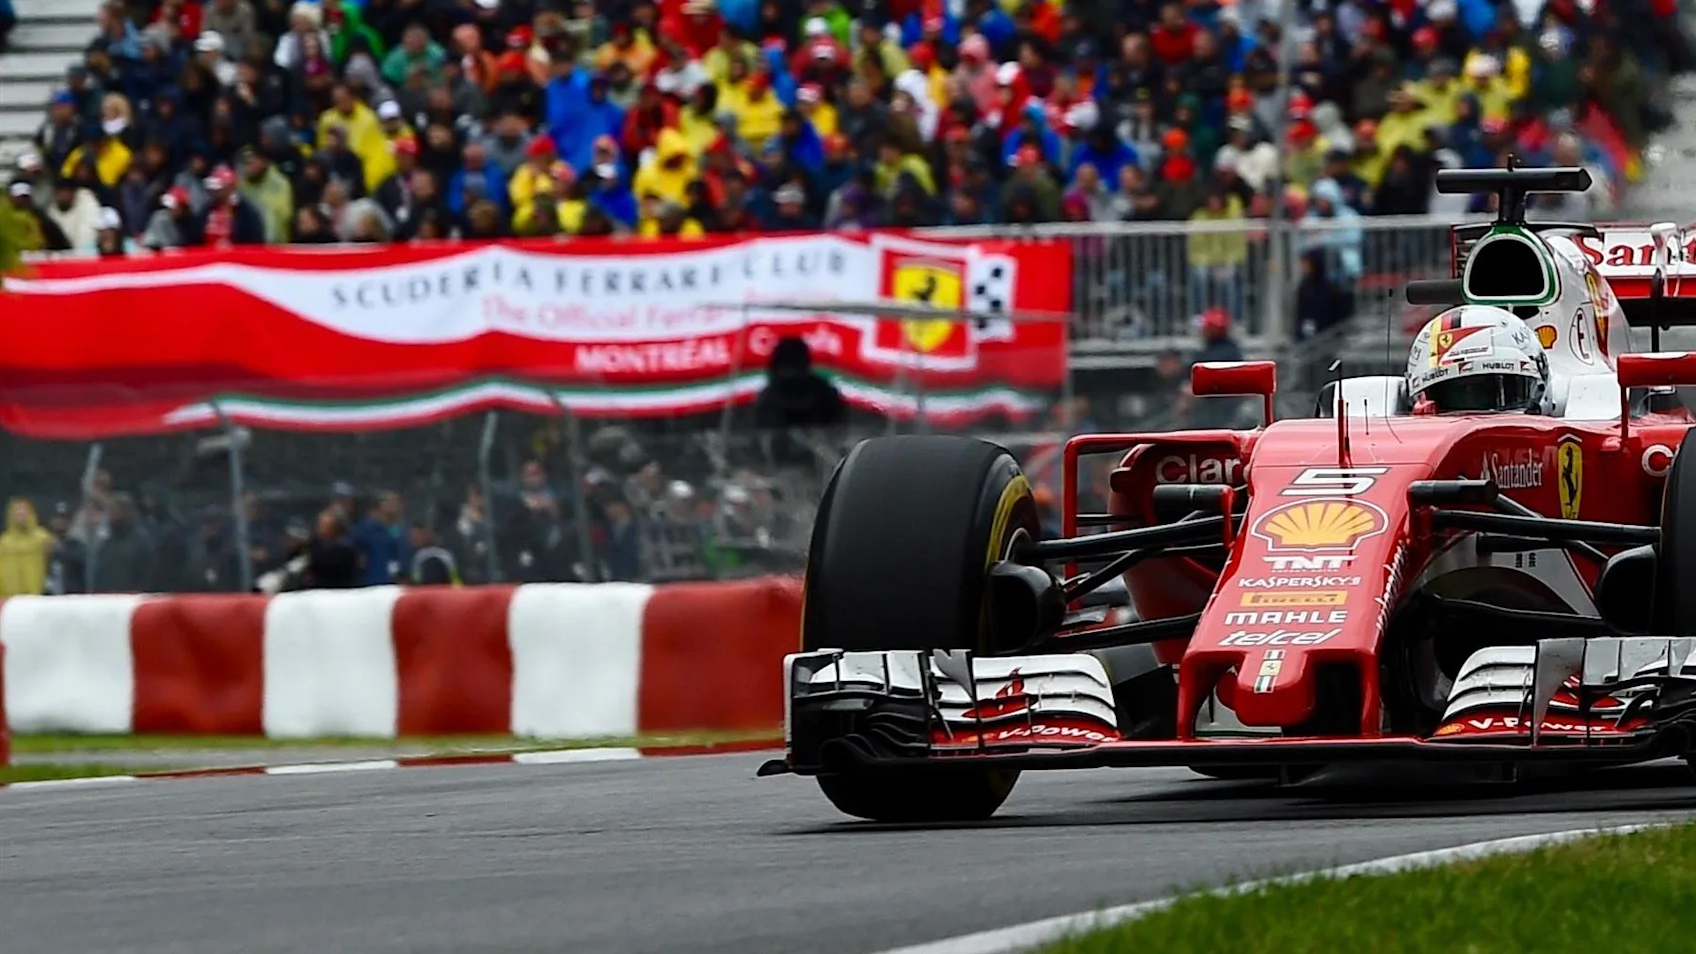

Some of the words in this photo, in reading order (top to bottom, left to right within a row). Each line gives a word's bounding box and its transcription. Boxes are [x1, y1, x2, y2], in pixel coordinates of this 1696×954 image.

[331, 260, 534, 308] SCUDERIA
[555, 263, 721, 293] FERRARI
[743, 249, 846, 281] CLUB
[576, 333, 730, 372] MONTRÉAL
[1483, 362, 1515, 372] HUBLOT
[1155, 454, 1251, 484] Clar
[1280, 467, 1390, 496] 5
[1491, 447, 1544, 489] Santander
[1262, 555, 1359, 570] TNT
[1225, 610, 1348, 625] MAHLE
[1218, 628, 1343, 647] telcel
